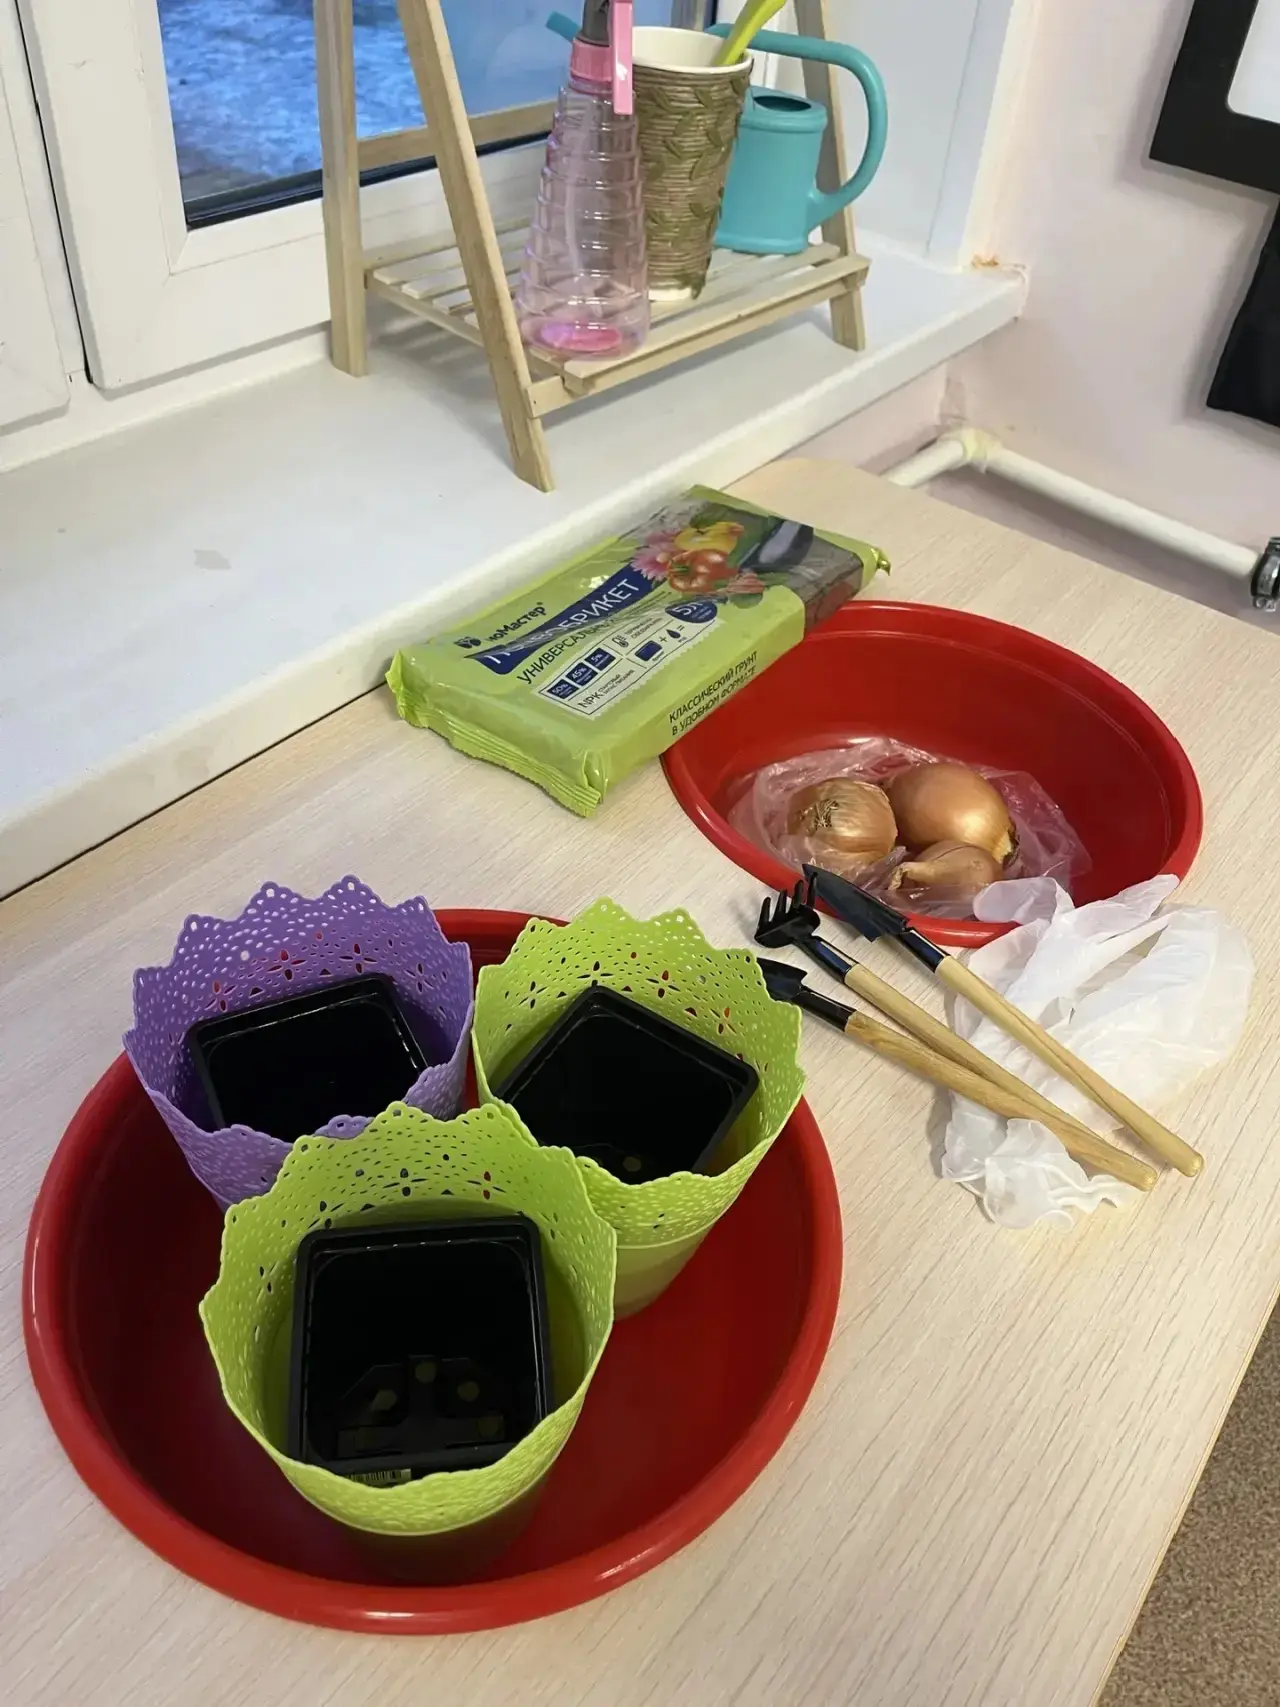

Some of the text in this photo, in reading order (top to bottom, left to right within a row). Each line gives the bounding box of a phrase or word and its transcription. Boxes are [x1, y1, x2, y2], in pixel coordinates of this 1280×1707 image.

[484, 604, 546, 642] оМастер
[572, 667, 587, 679] 45%
[552, 683, 568, 694] 50%
[578, 691, 605, 708] NPK
[669, 651, 757, 723] КЛАССИЧЕСКИЙ ГРУНТ
[672, 725, 678, 736] В
[680, 695, 719, 732] УДОБНОМ
